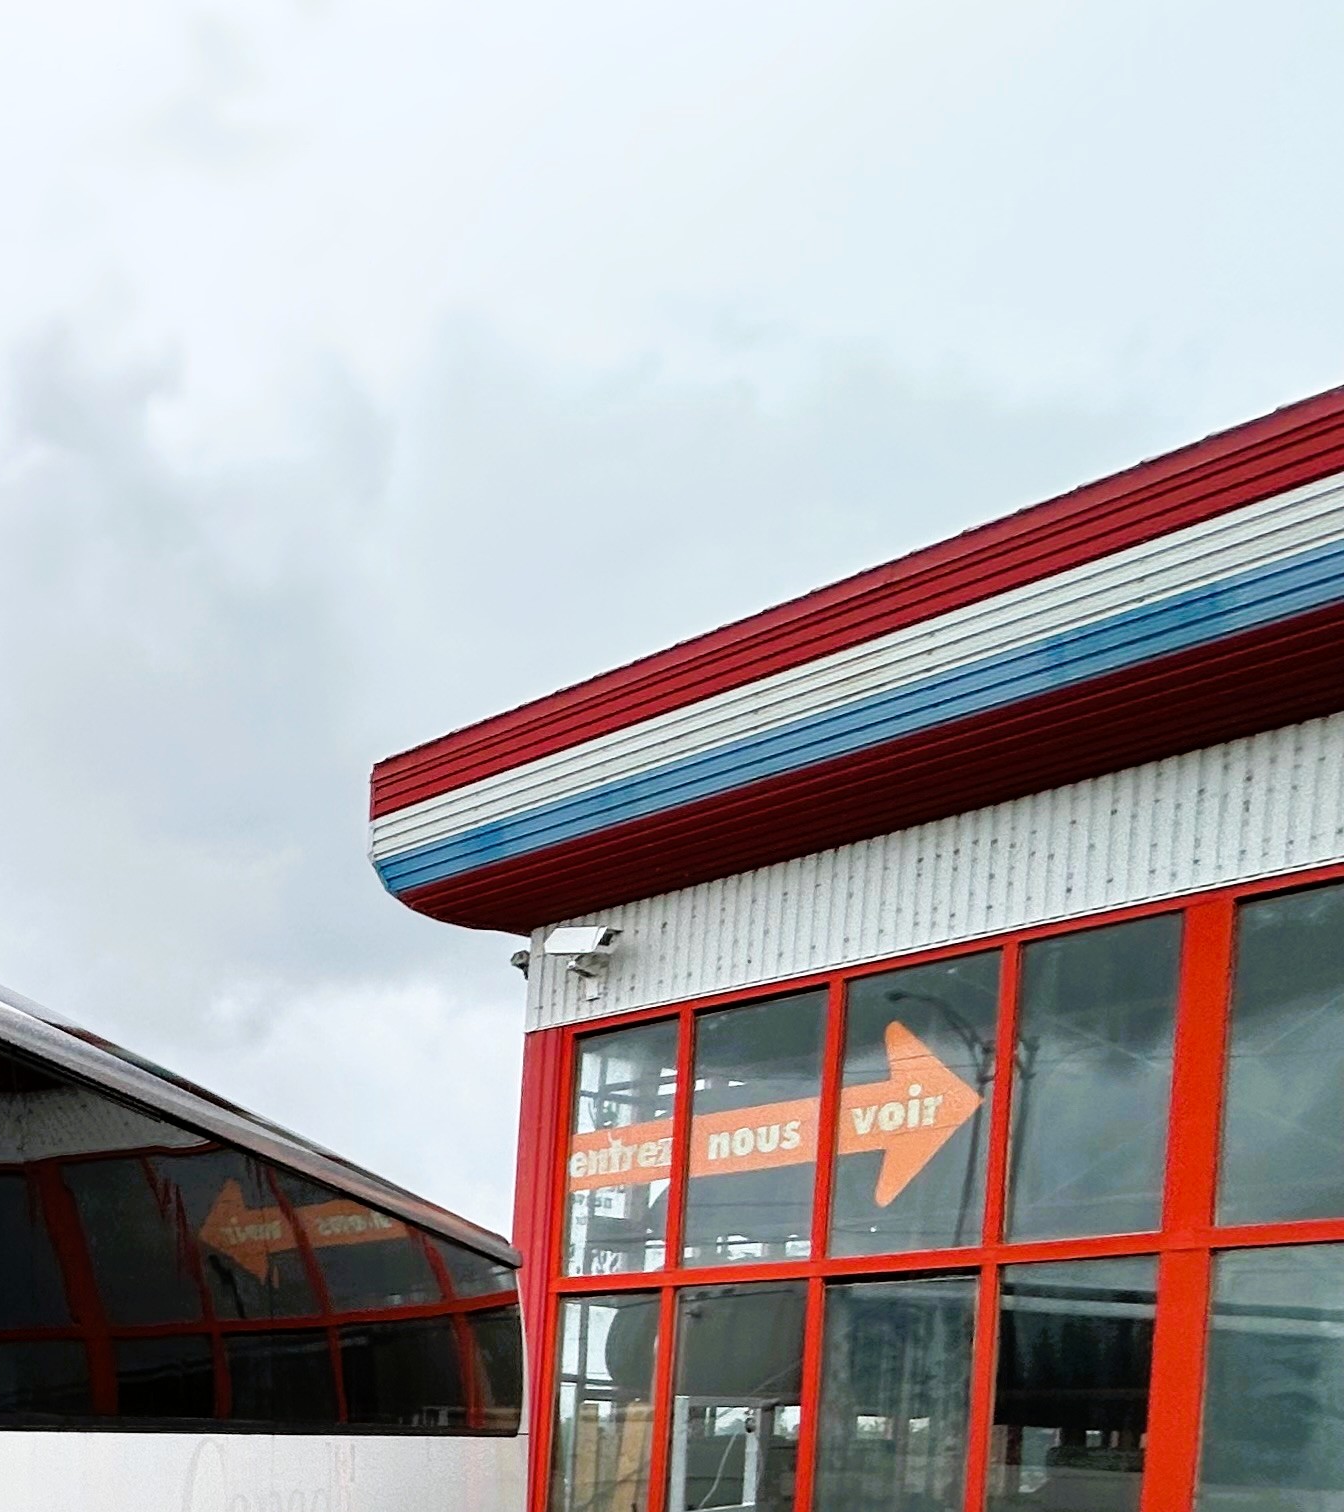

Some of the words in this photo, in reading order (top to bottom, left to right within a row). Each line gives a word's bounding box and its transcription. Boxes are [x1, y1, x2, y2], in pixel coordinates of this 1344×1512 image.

[569, 1137, 673, 1178] entrez
[708, 1120, 801, 1160] nous
[851, 1085, 944, 1135] voir
